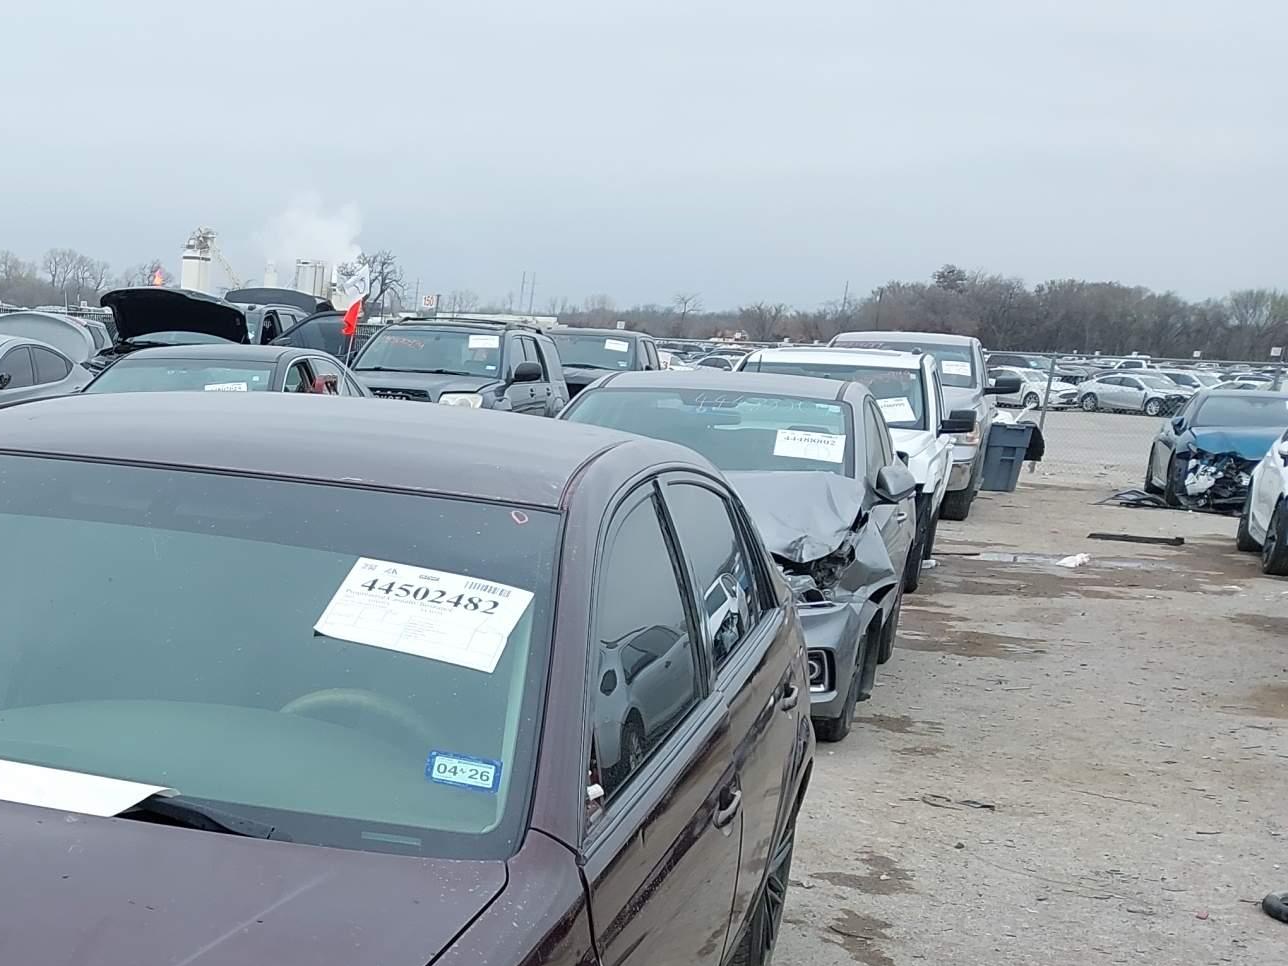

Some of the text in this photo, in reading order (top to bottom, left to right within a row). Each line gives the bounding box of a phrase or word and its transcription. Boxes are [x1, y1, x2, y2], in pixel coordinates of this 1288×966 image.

[361, 578, 500, 615] 44502482
[436, 763, 490, 782] 04 26
